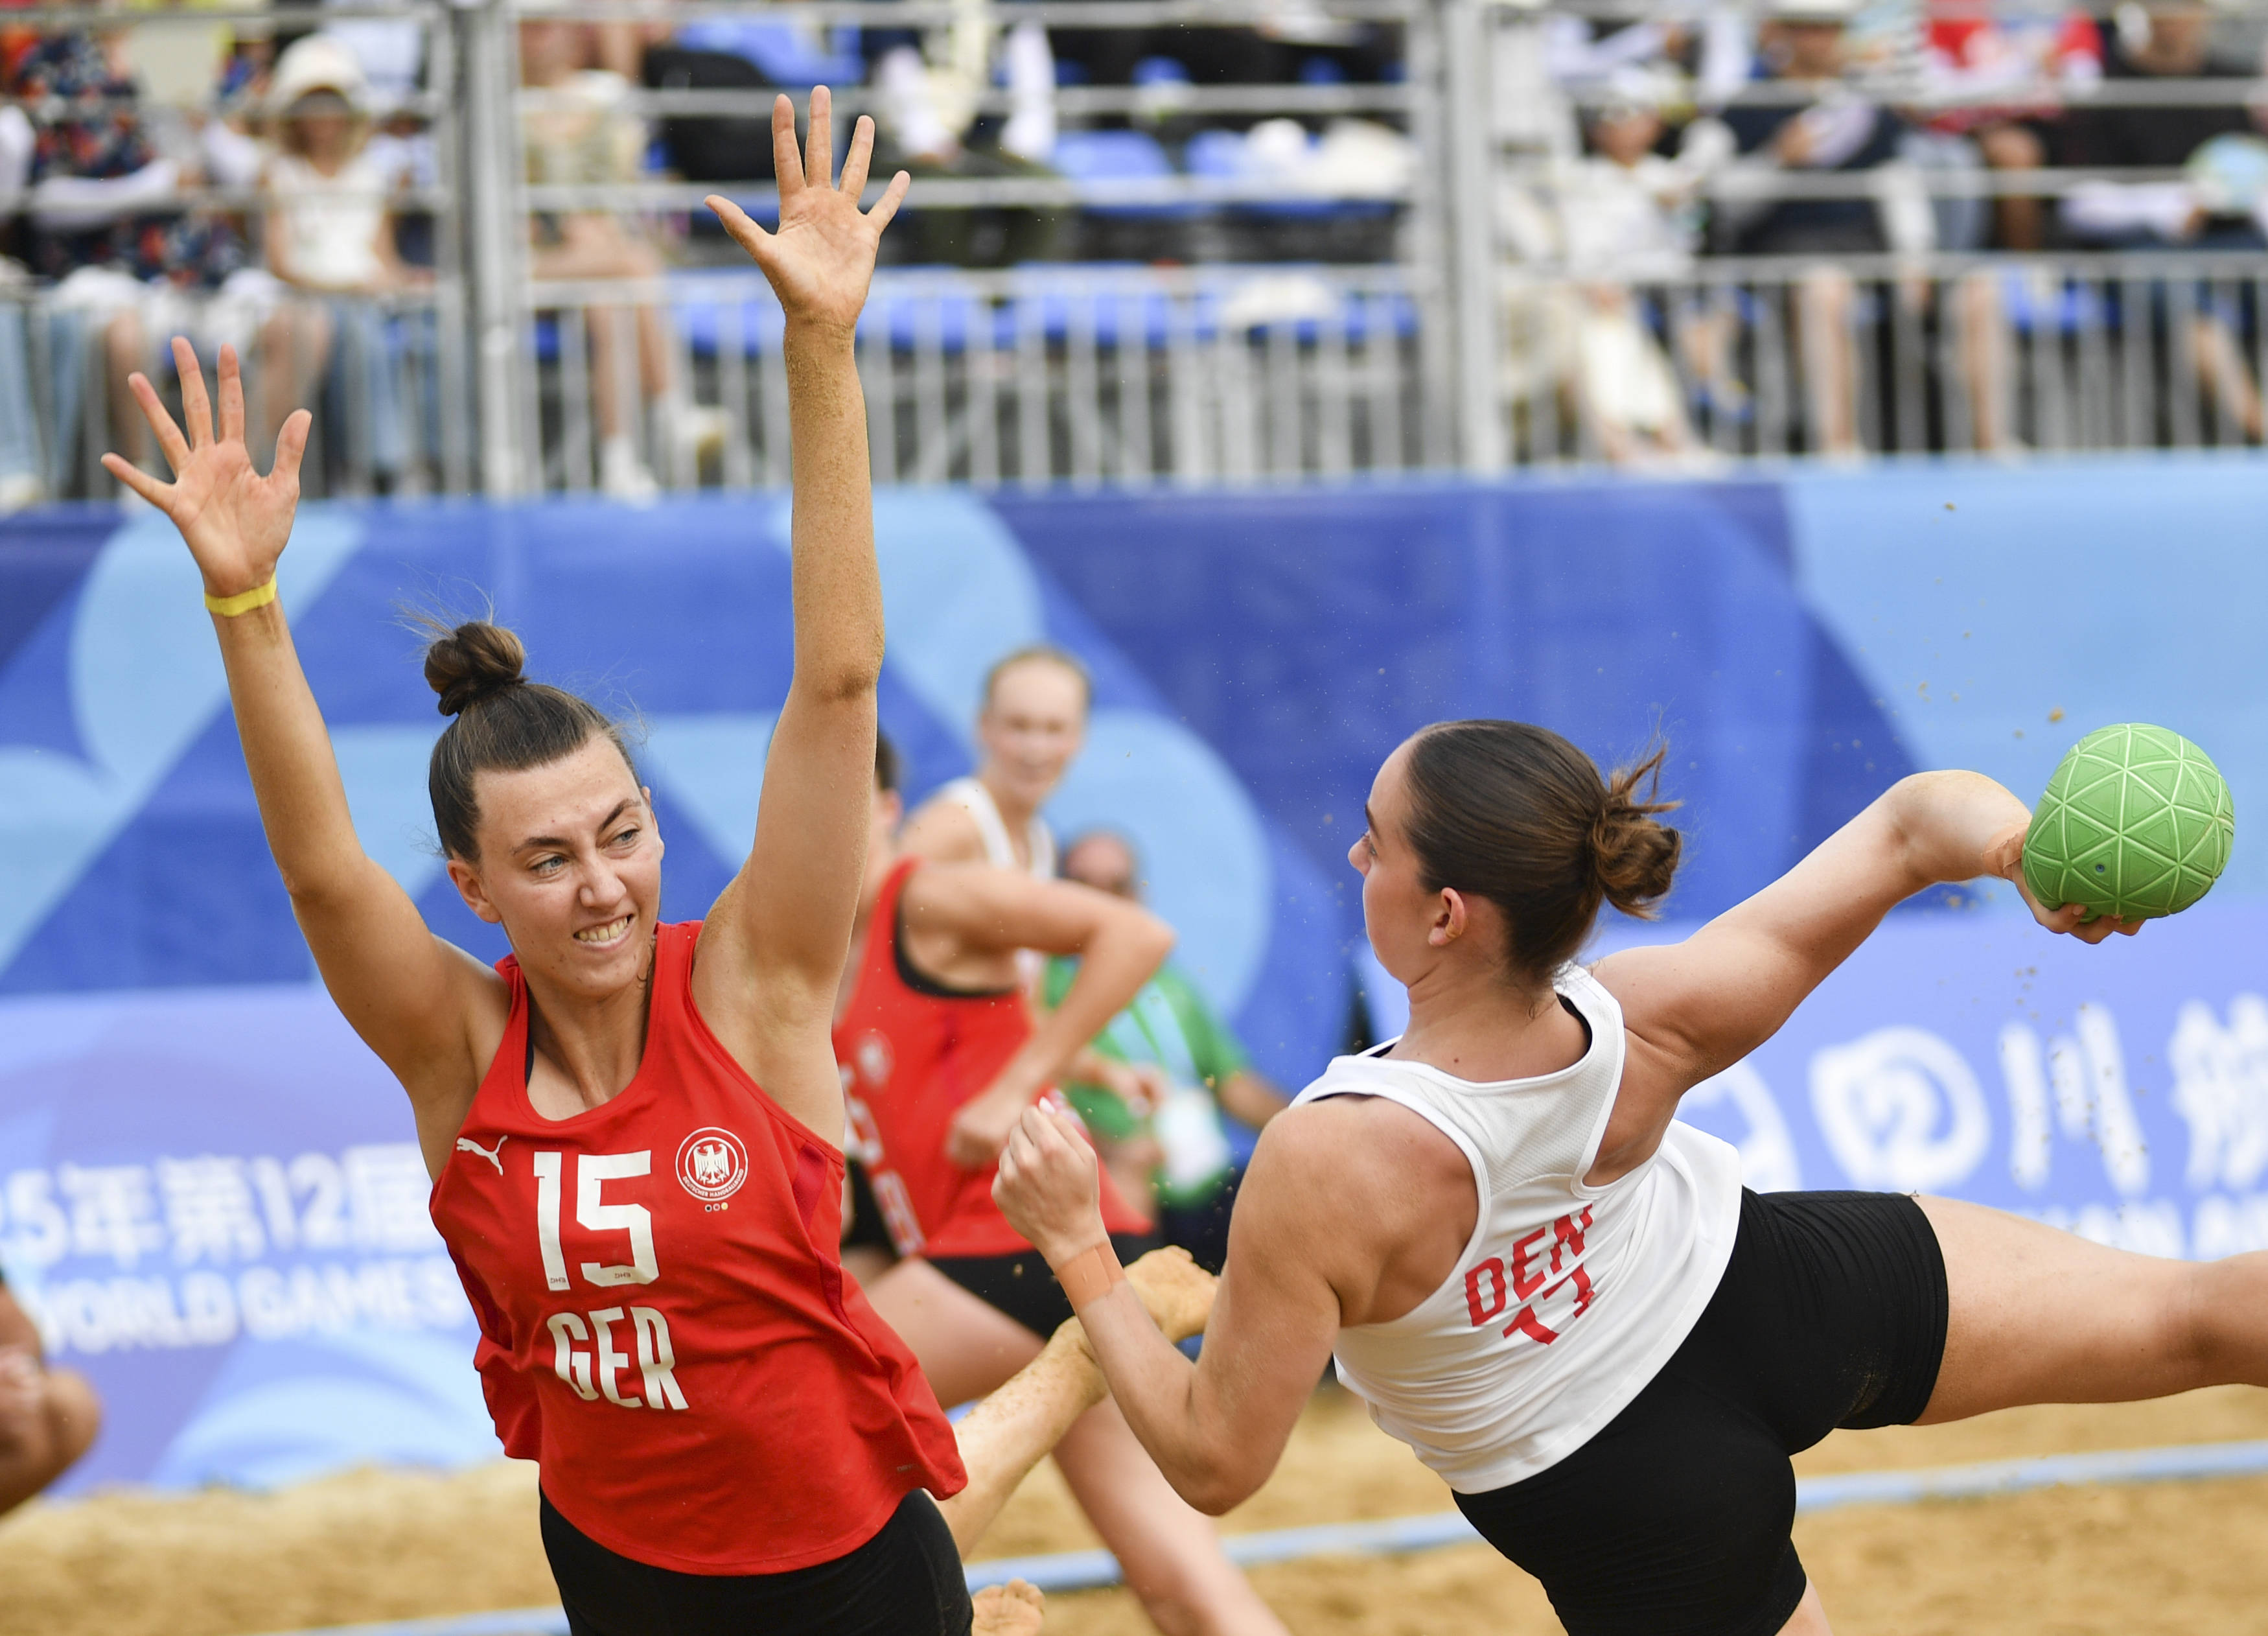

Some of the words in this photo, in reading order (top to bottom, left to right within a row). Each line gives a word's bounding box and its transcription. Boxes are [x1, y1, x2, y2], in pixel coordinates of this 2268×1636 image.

[533, 1150, 660, 1291] 15
[1464, 1203, 1593, 1327] DEN
[546, 1305, 689, 1410] GER
